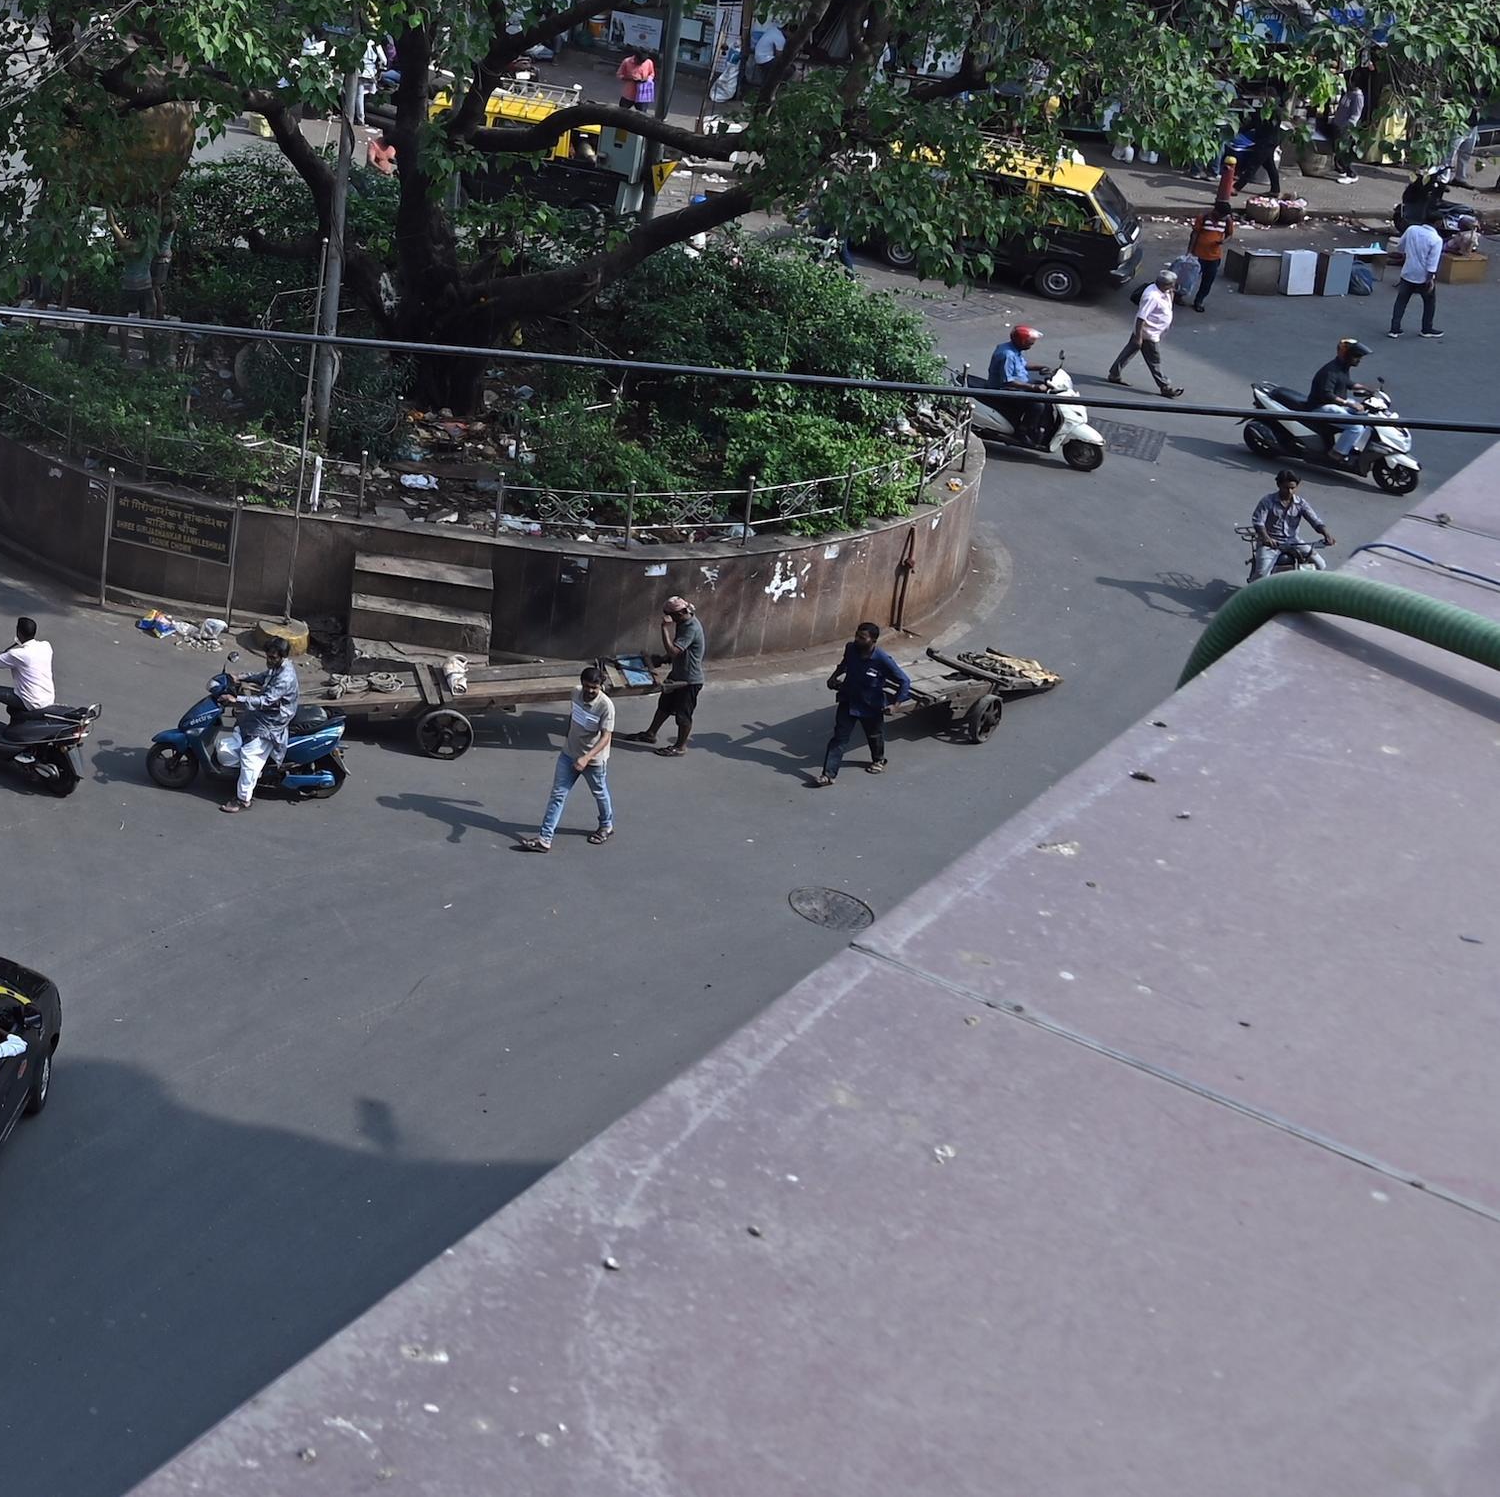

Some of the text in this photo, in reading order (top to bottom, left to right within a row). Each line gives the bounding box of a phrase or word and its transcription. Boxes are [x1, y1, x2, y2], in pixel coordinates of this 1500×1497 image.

[116, 519, 136, 531] SHREE
[178, 520, 199, 535] चौक
[189, 713, 214, 726] electric
